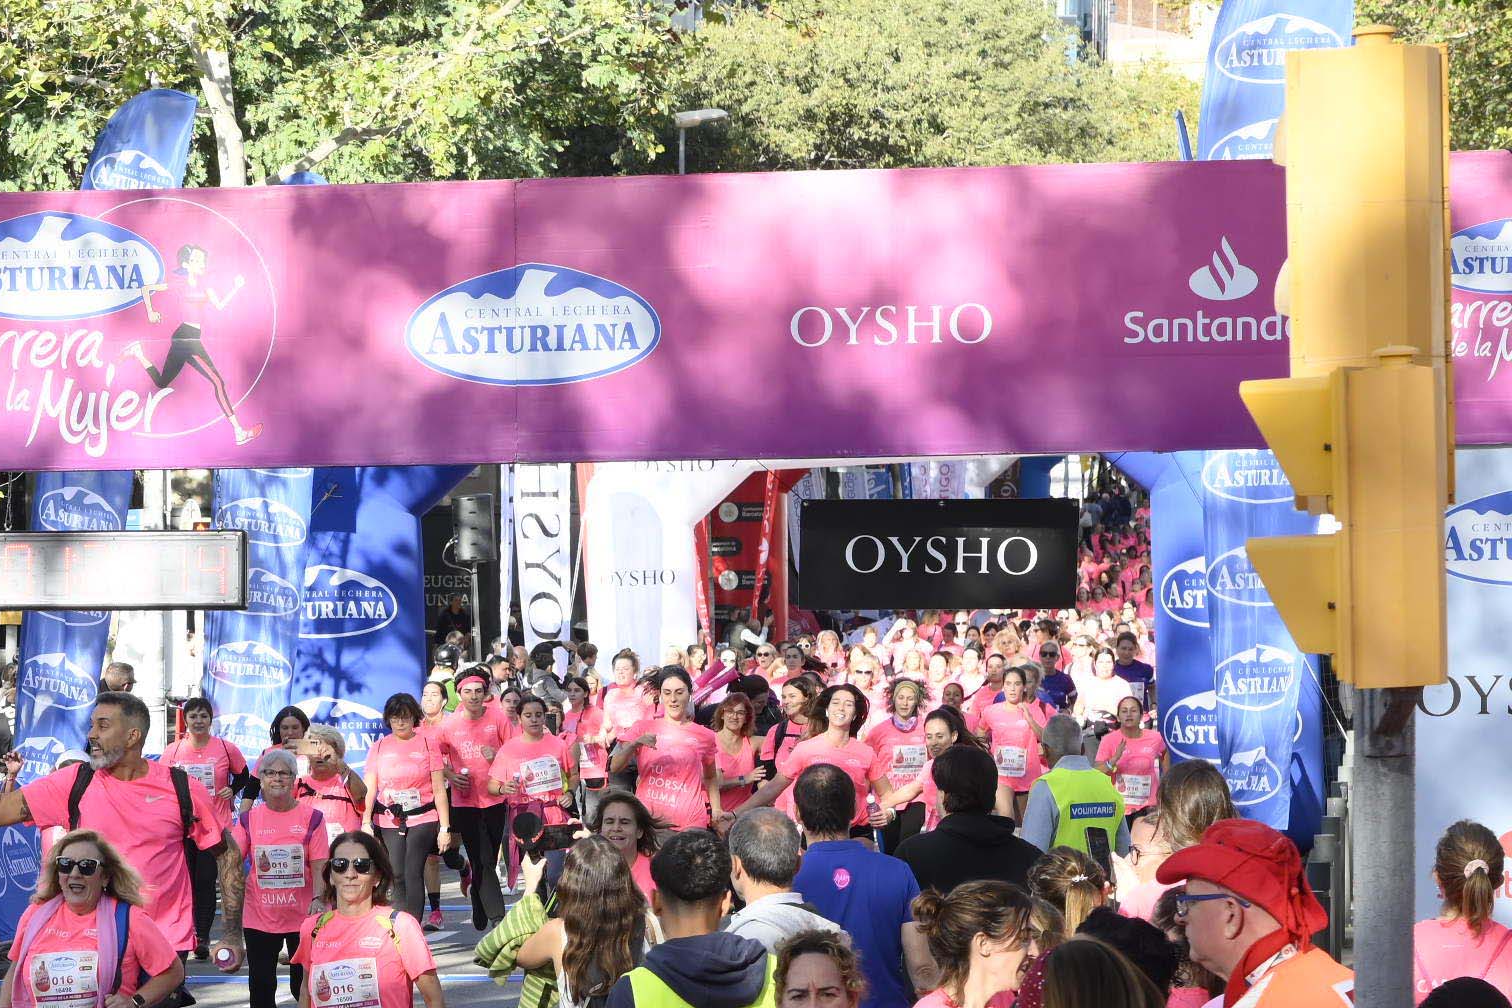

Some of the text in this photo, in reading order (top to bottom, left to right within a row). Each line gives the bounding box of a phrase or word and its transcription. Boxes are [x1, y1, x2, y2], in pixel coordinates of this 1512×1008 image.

[464, 304, 633, 319] CENTRAL LECHERA
[790, 302, 993, 347] OYSHO
[425, 311, 641, 356] ASTURIANA
[1474, 328, 1492, 357] la
[5, 373, 31, 412] la
[26, 362, 174, 457] Mujer
[1213, 463, 1290, 488] ASTURIA
[223, 512, 300, 539] ASTURIANA
[1471, 523, 1512, 533] CENT
[519, 463, 564, 640] OYSH
[844, 533, 1039, 576] OYSHO
[248, 588, 294, 609] URIANA
[334, 589, 383, 598] LECHERA
[1167, 579, 1207, 609] AST
[1416, 674, 1512, 717] OY
[1170, 715, 1218, 744] ASTU
[261, 893, 297, 905] SUMA
[51, 975, 74, 986] 016
[332, 984, 355, 995] 016
